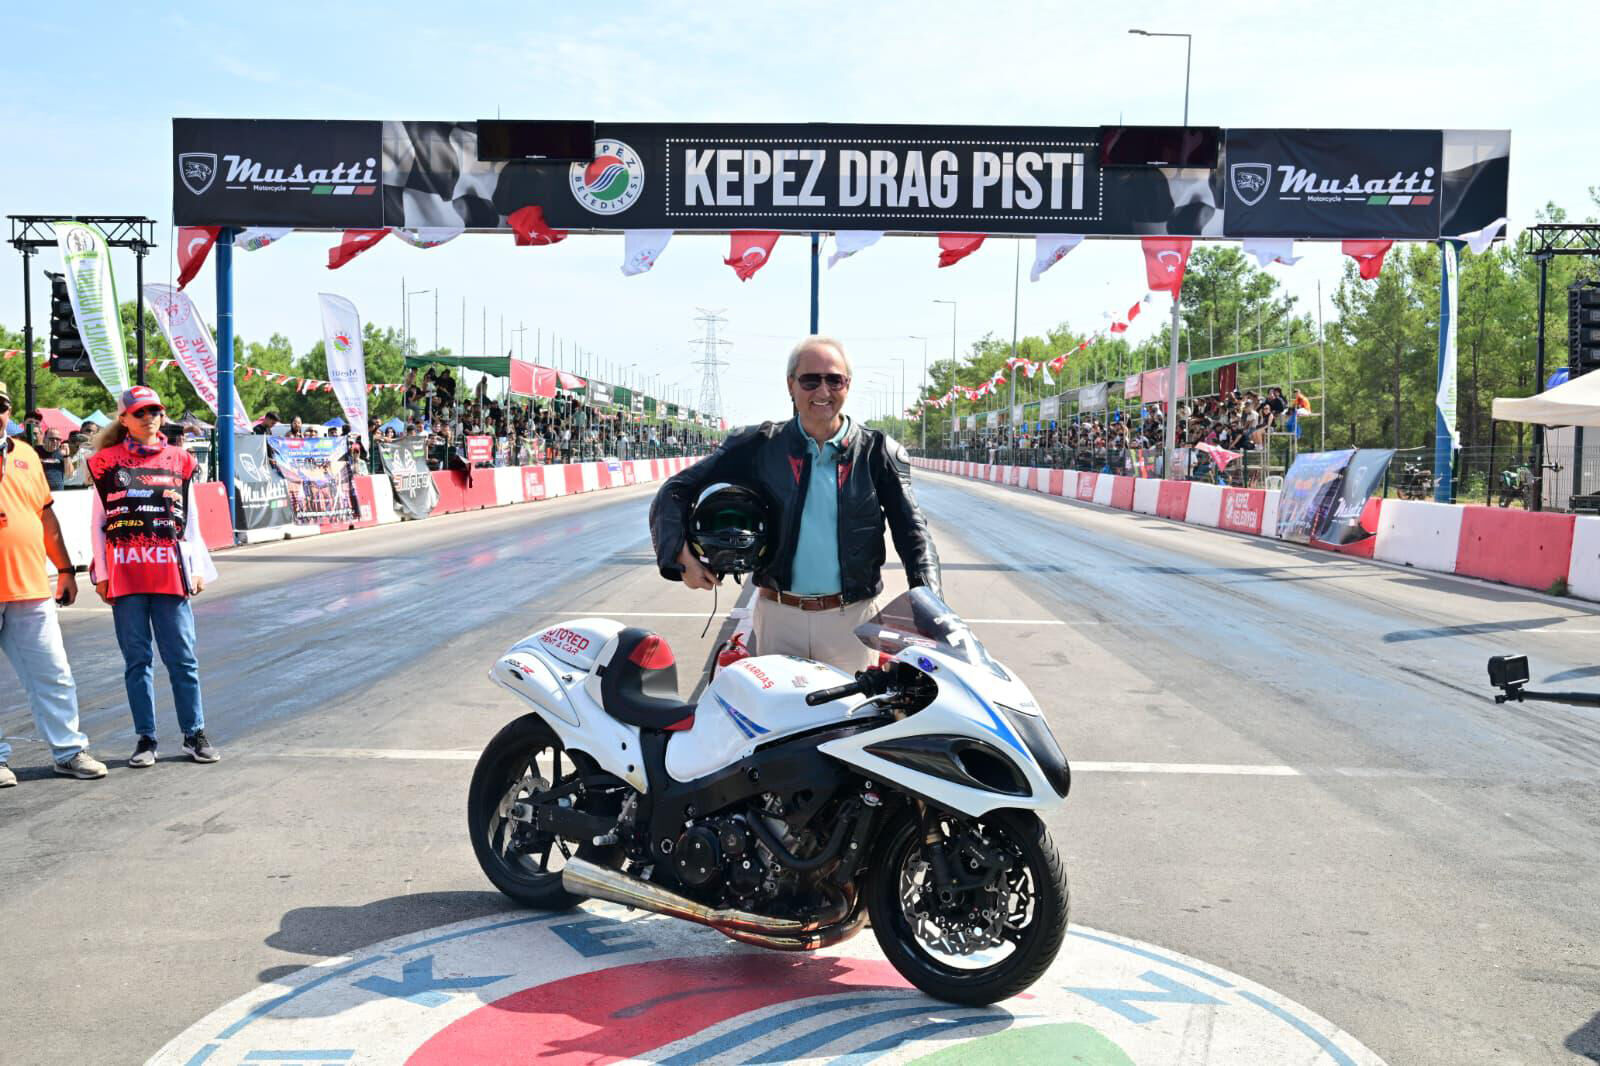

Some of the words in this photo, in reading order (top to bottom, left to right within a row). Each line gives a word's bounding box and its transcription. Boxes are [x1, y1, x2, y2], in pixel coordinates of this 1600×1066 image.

[222, 155, 377, 183] Musatti
[684, 148, 827, 207] KEPEZ
[839, 150, 959, 208] DRAG
[1277, 165, 1435, 194] Musatti
[253, 184, 287, 192] Motorcycle
[1307, 195, 1342, 203] Motorcycle
